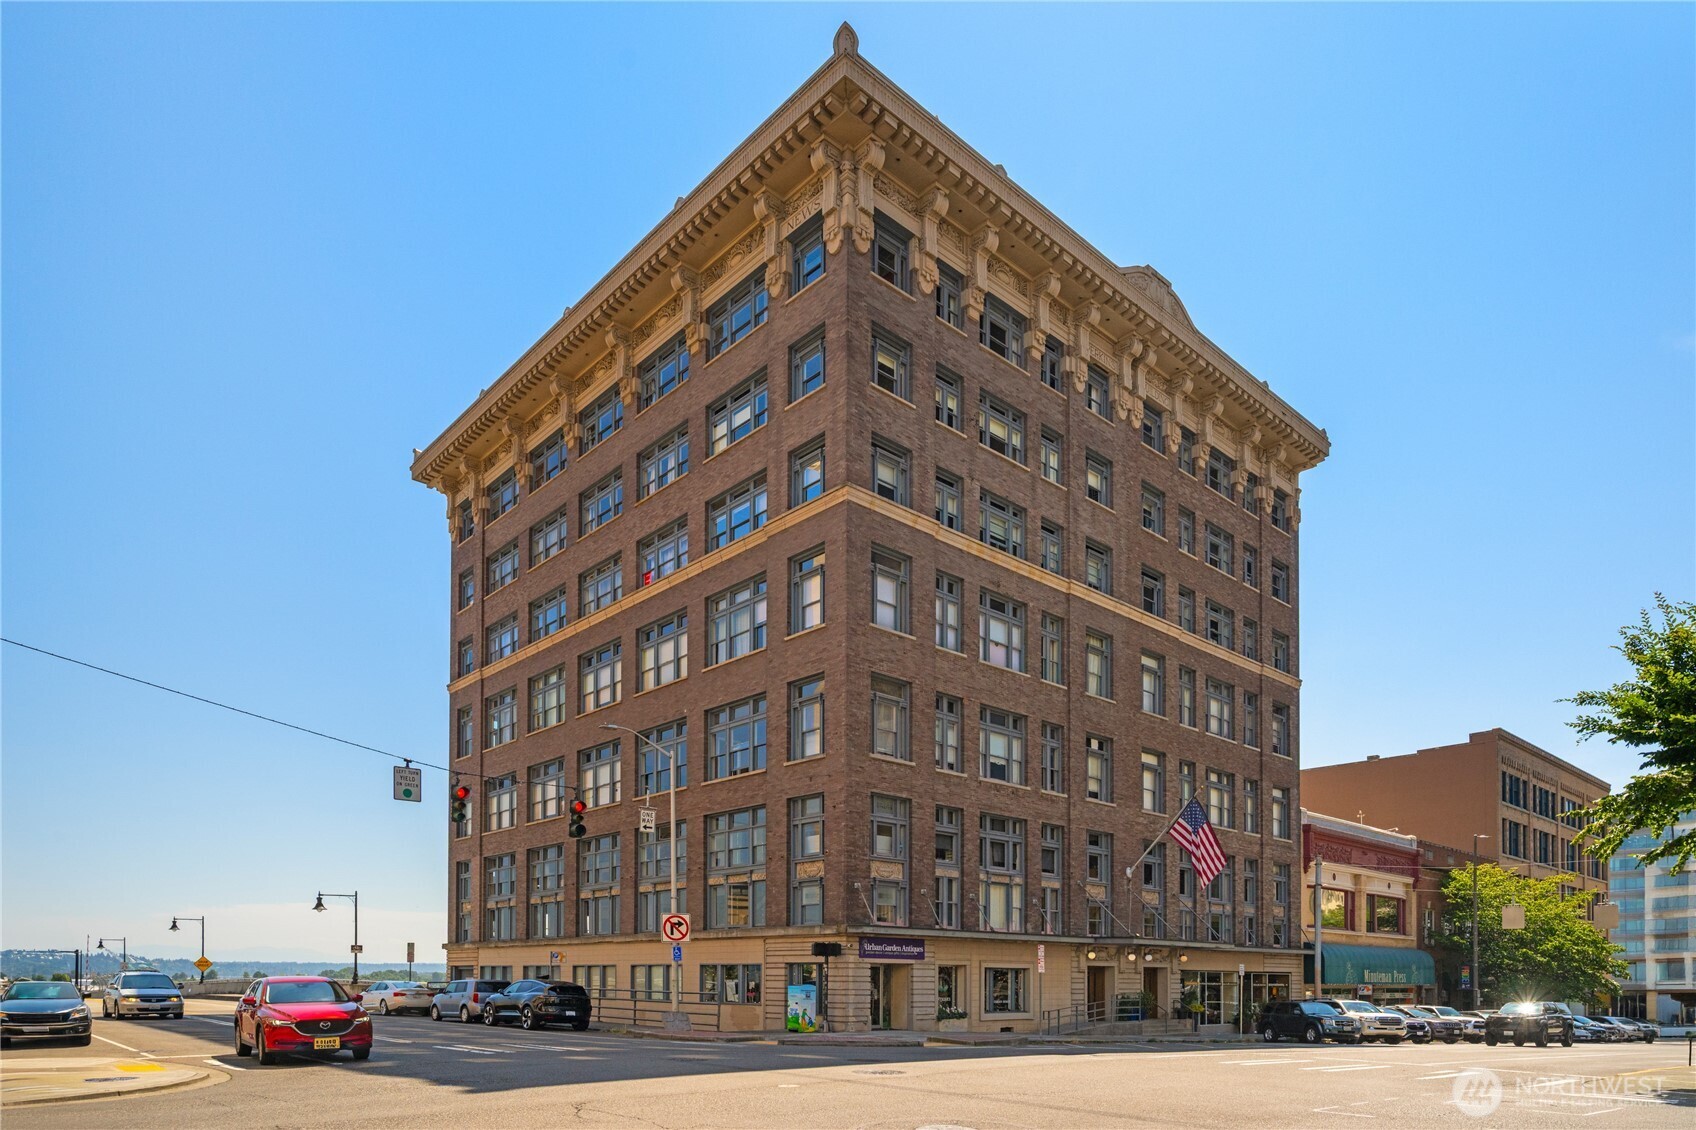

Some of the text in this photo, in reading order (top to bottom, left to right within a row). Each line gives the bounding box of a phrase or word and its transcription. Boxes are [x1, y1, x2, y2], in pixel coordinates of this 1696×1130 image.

[787, 202, 821, 232] NEWS
[641, 811, 654, 819] ONE
[641, 817, 654, 825] WAY
[864, 943, 883, 951] Urban
[883, 943, 901, 952] Garden
[901, 944, 924, 955] Antiques
[1364, 969, 1407, 983] Minuteman Press
